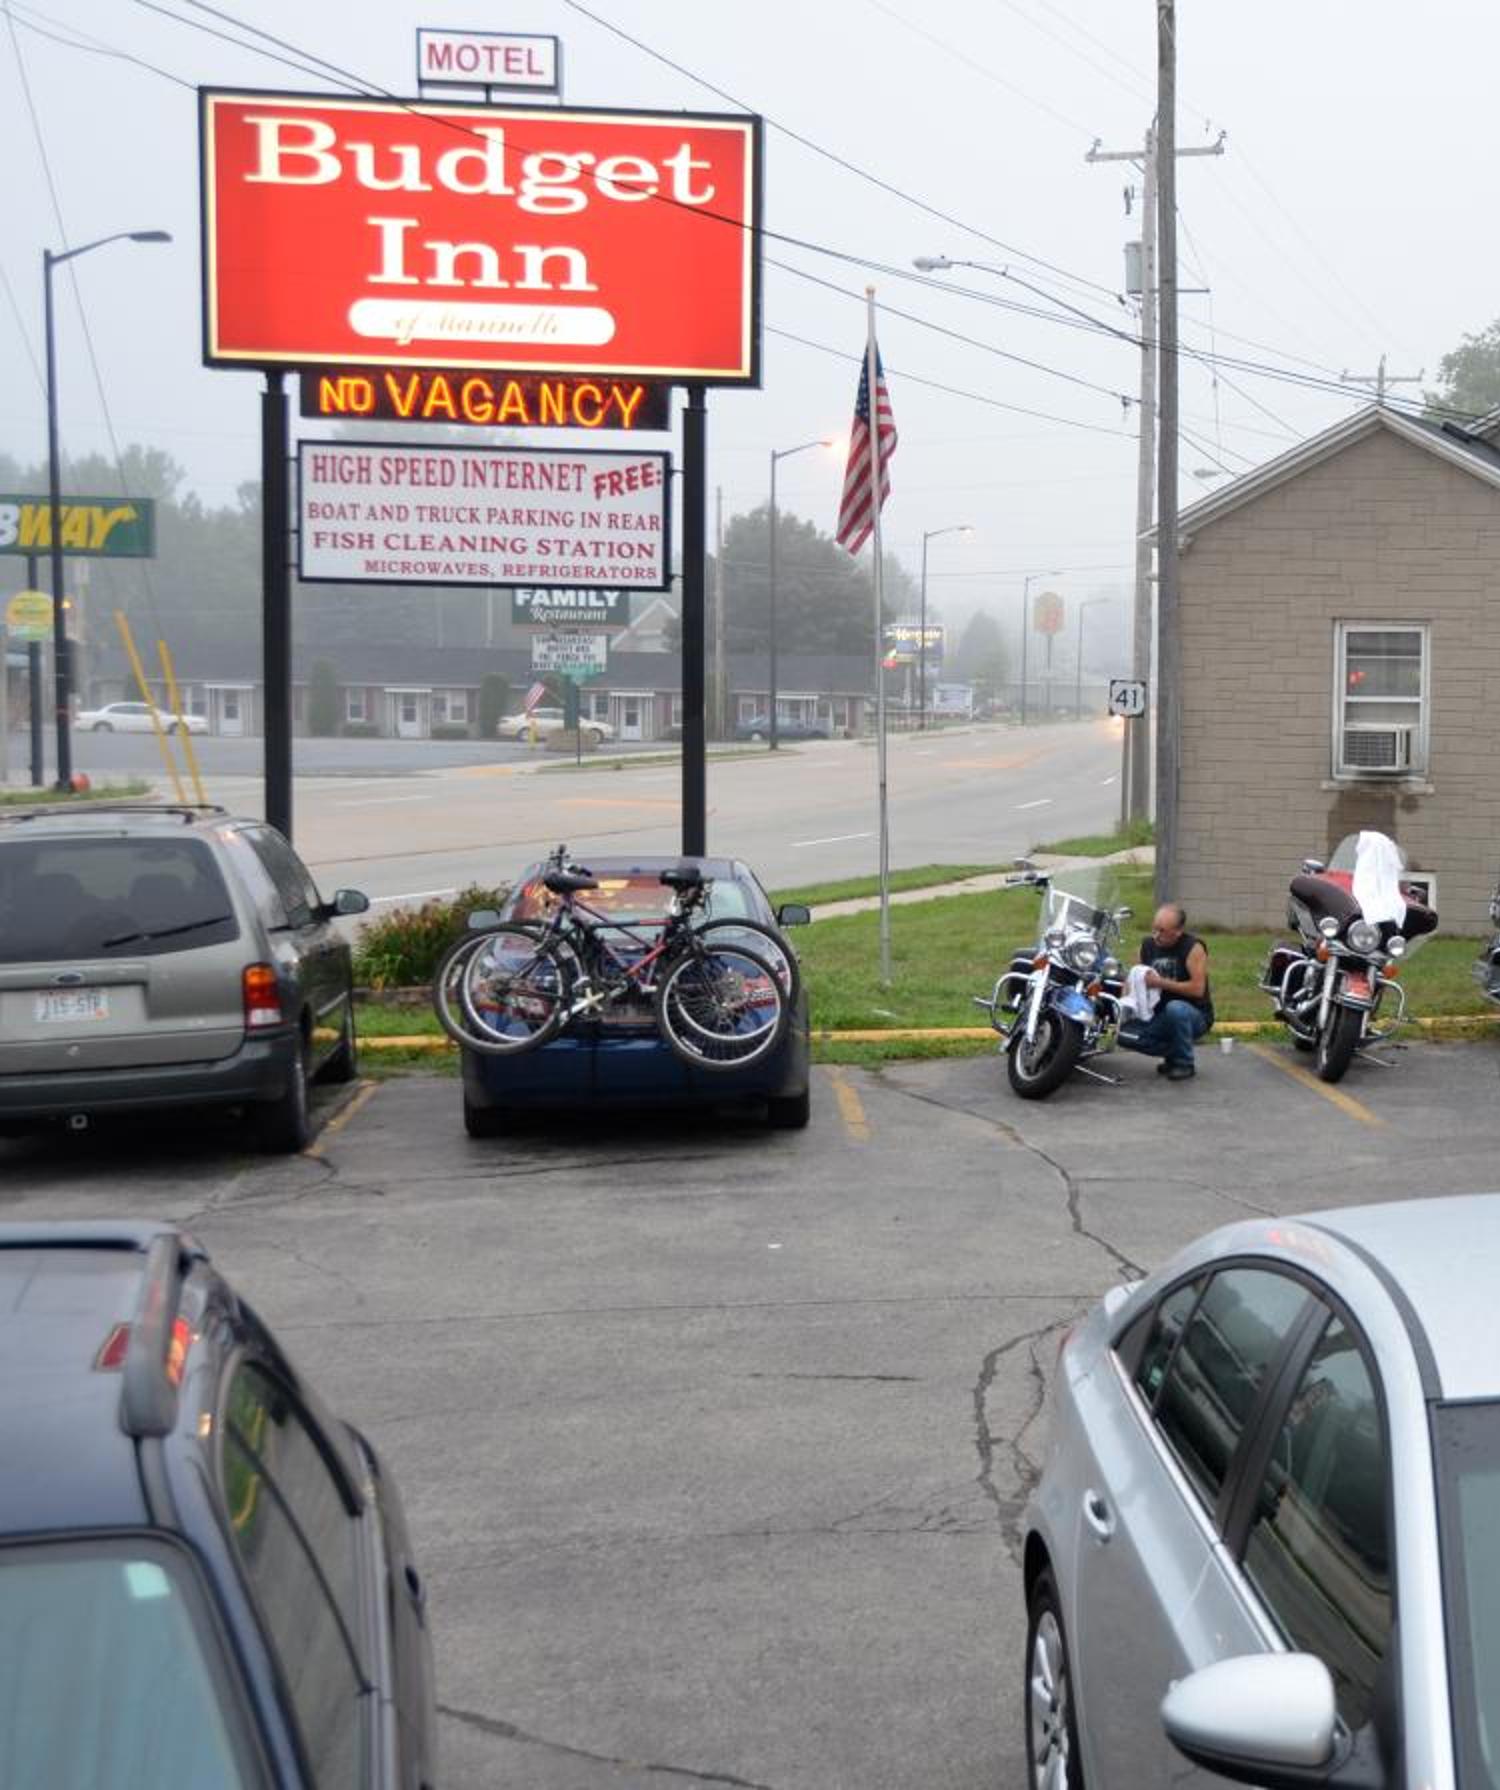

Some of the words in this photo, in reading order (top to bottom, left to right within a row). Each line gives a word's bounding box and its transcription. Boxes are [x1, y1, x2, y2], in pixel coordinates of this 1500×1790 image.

[426, 42, 545, 76] MOTEL
[242, 114, 716, 215] Budget
[366, 216, 599, 292] Inn
[319, 376, 373, 414] NO
[385, 373, 643, 428] VACANCY
[312, 453, 373, 485] HIGH
[379, 456, 456, 488] SPEED
[461, 459, 586, 493] INTERNET
[308, 501, 361, 522] BOAT
[365, 504, 409, 523] AND
[416, 505, 480, 525] TRUCK
[486, 507, 575, 528] PARKING
[580, 511, 602, 530] IN
[607, 512, 662, 533] REAR
[313, 532, 375, 550] FISH
[383, 535, 528, 554] CLEANING
[536, 540, 656, 559] STATION
[502, 563, 658, 580] REFRIGERATORS
[515, 589, 620, 607] FAMILY
[529, 607, 608, 624] Restaurant
[1115, 689, 1137, 709] 41
